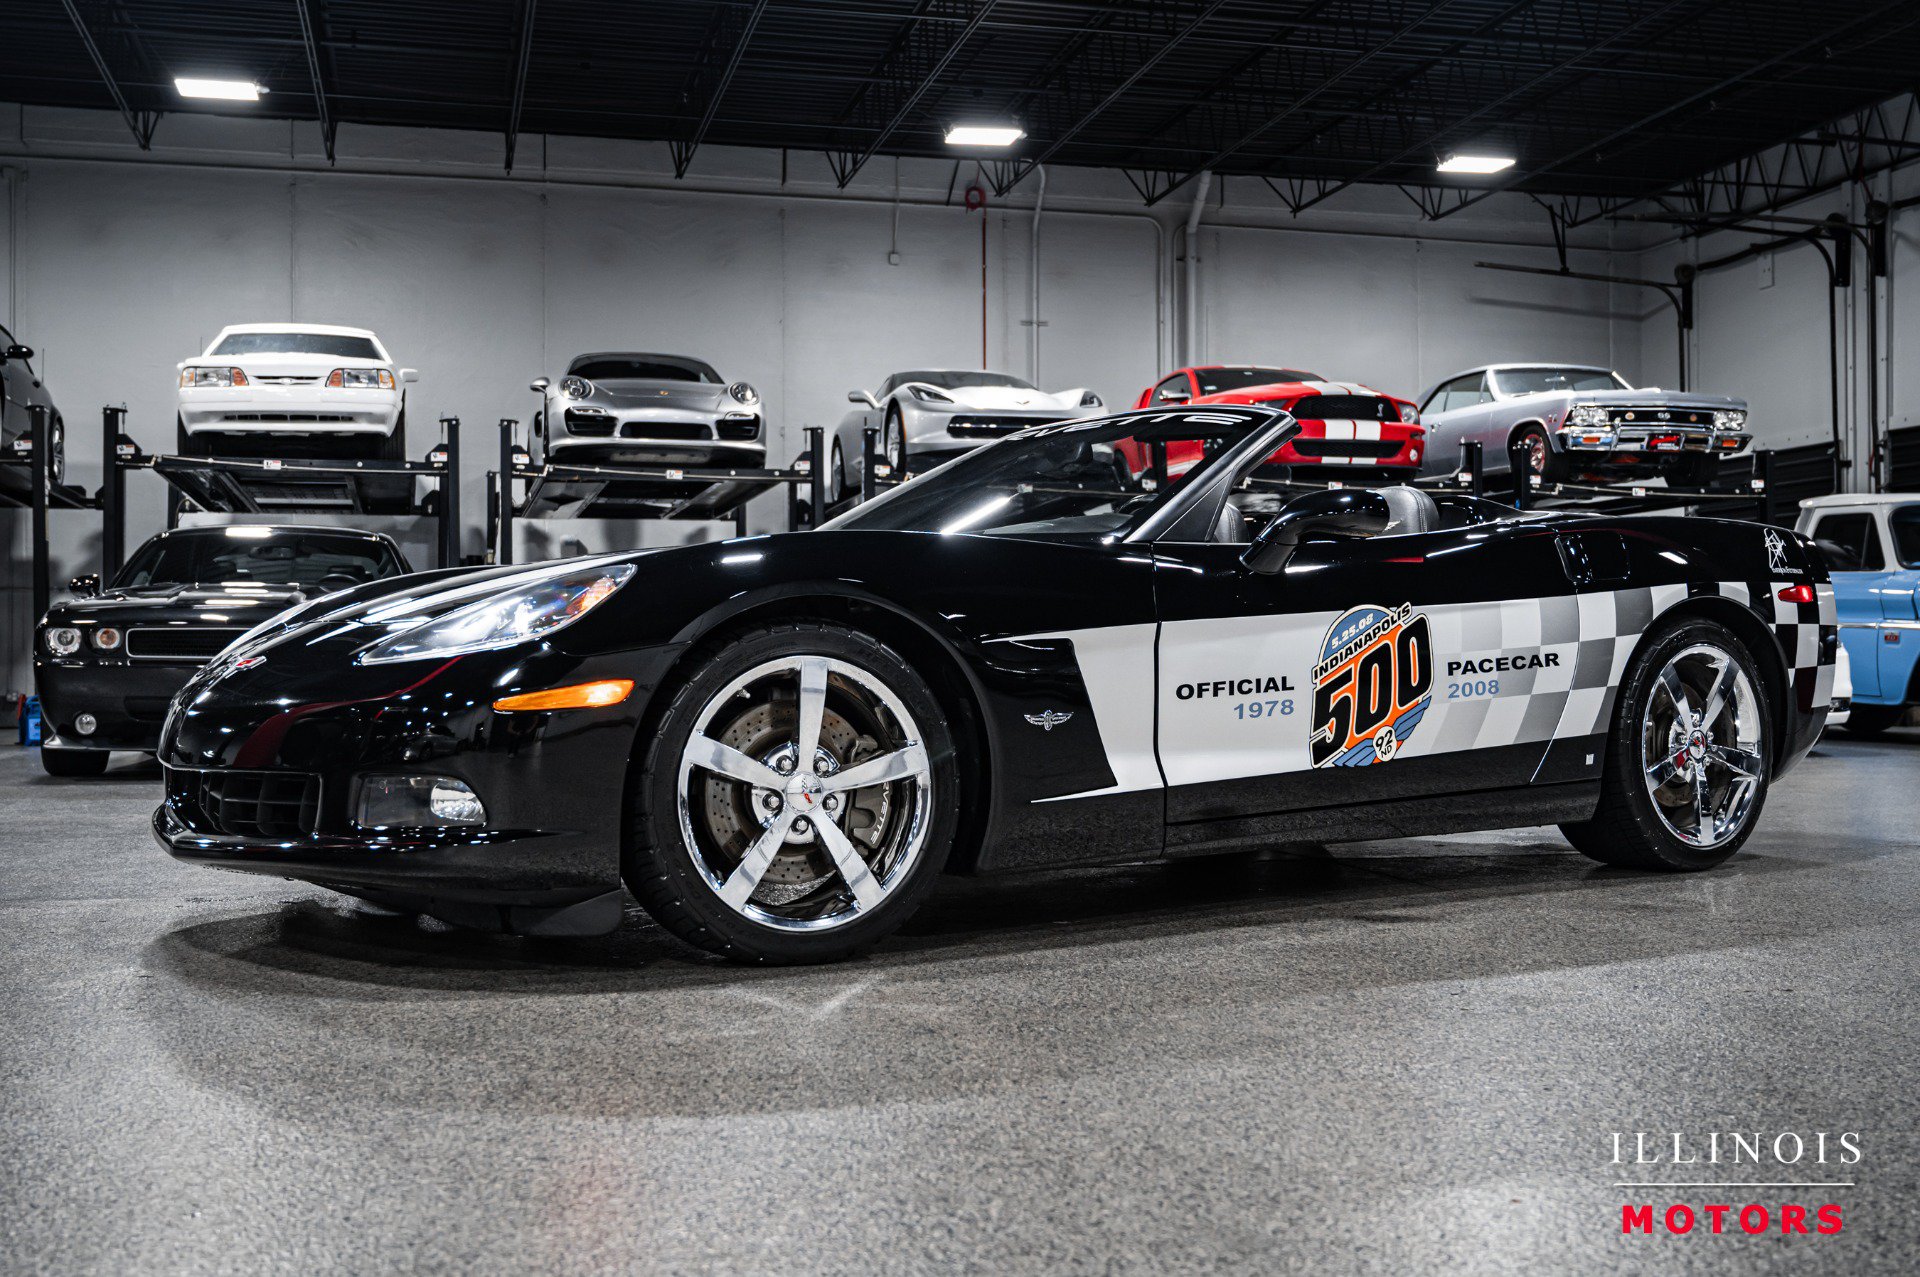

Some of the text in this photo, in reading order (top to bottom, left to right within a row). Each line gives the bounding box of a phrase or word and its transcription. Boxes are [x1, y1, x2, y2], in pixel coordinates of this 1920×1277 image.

[1313, 604, 1411, 680] INDIANAPOLIS
[1331, 612, 1374, 650] 5.25.08
[1446, 652, 1560, 677] PACECAR
[1175, 675, 1295, 700] OFFICIAL
[1311, 616, 1432, 766] 500
[1447, 679, 1500, 699] 2008
[1233, 699, 1295, 720] 1978
[1375, 729, 1393, 751] 92
[1380, 744, 1392, 758] ND
